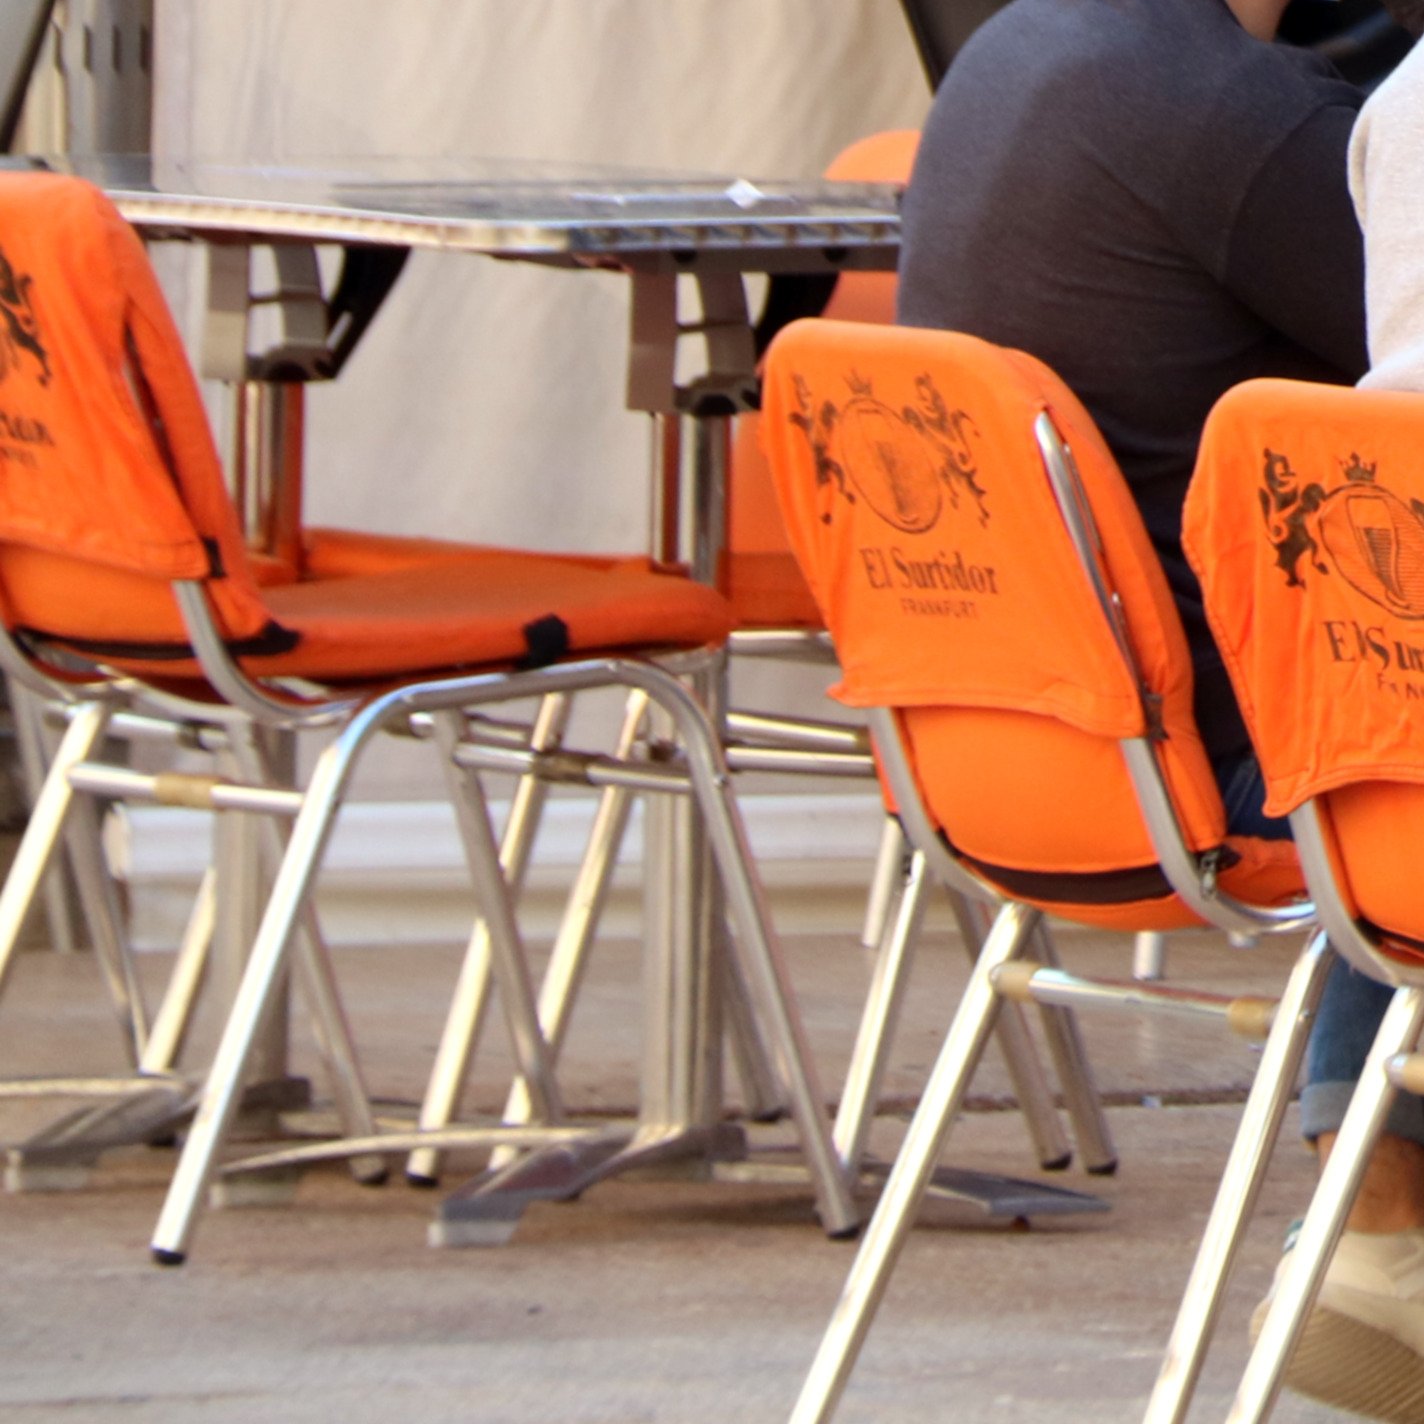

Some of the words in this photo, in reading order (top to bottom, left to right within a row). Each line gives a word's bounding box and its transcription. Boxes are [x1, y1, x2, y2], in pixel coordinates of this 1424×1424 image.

[860, 548, 893, 589] El
[890, 546, 998, 594] Surtidor
[1323, 620, 1369, 663] El
